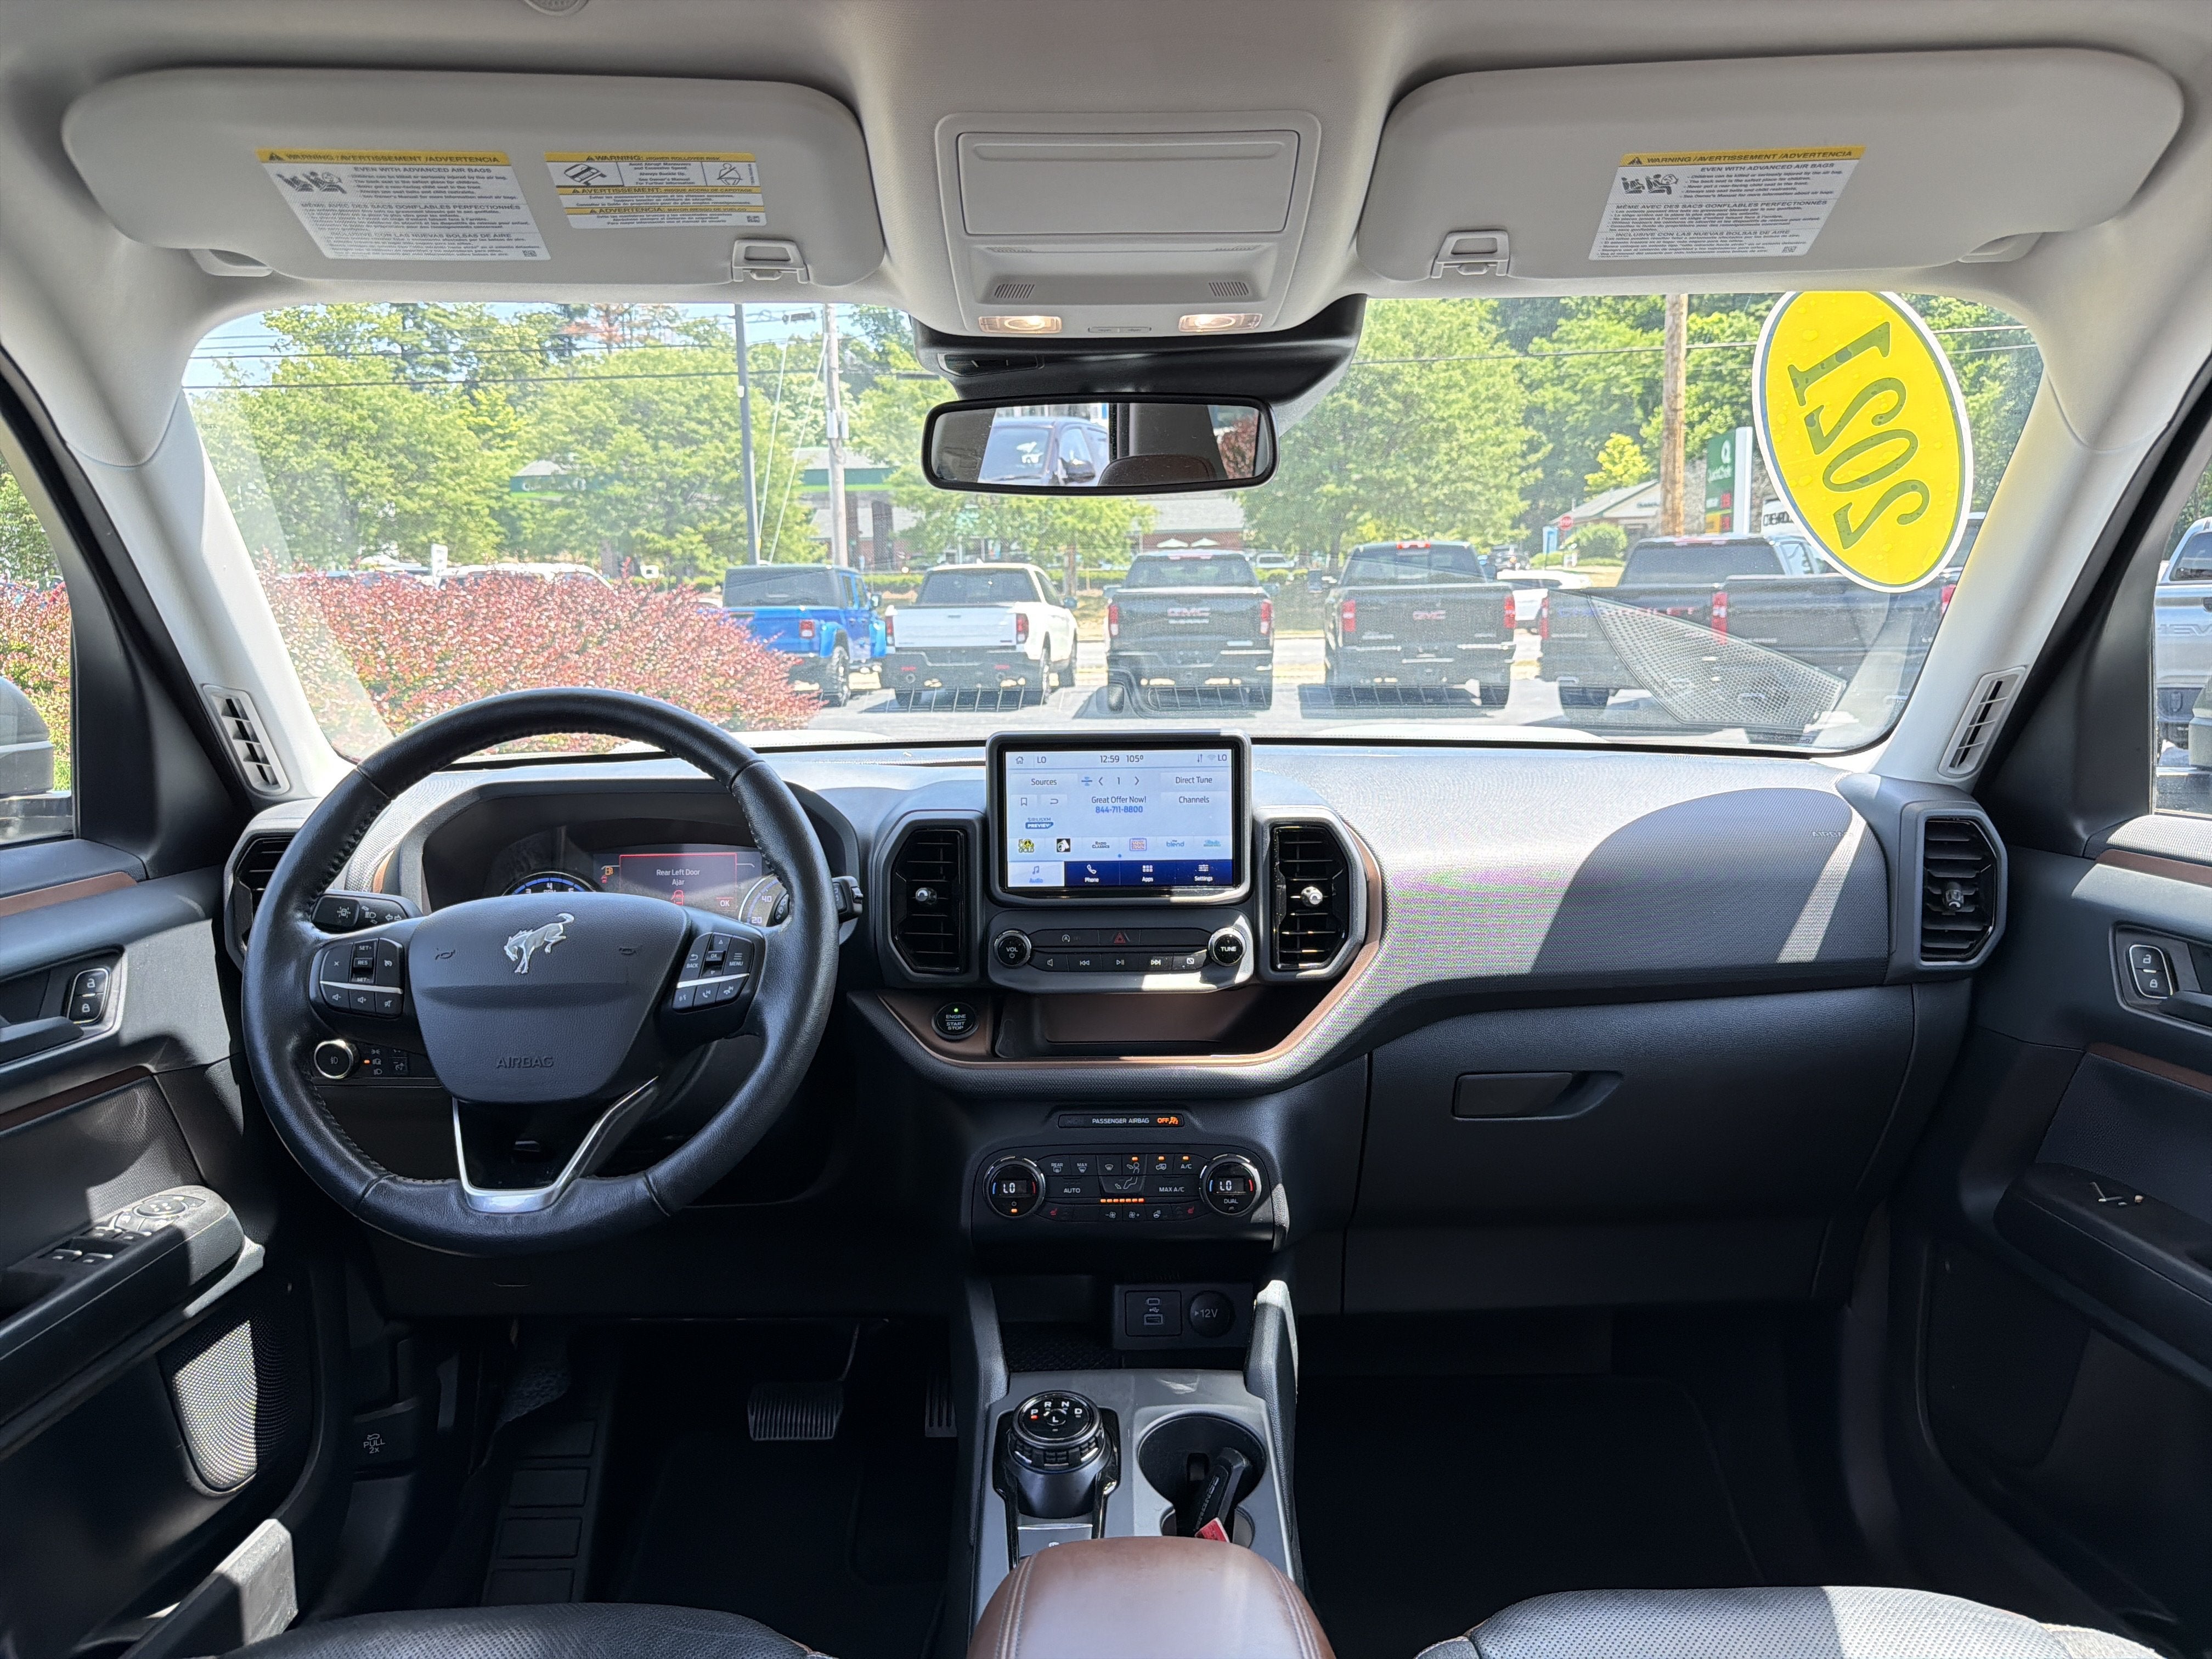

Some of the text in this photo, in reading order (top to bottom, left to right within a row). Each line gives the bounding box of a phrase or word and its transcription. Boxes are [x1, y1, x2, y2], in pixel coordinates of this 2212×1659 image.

[1100, 755, 1120, 763] 12:59
[496, 1056, 555, 1069] AIRBAG
[363, 1438, 386, 1448] PULL
